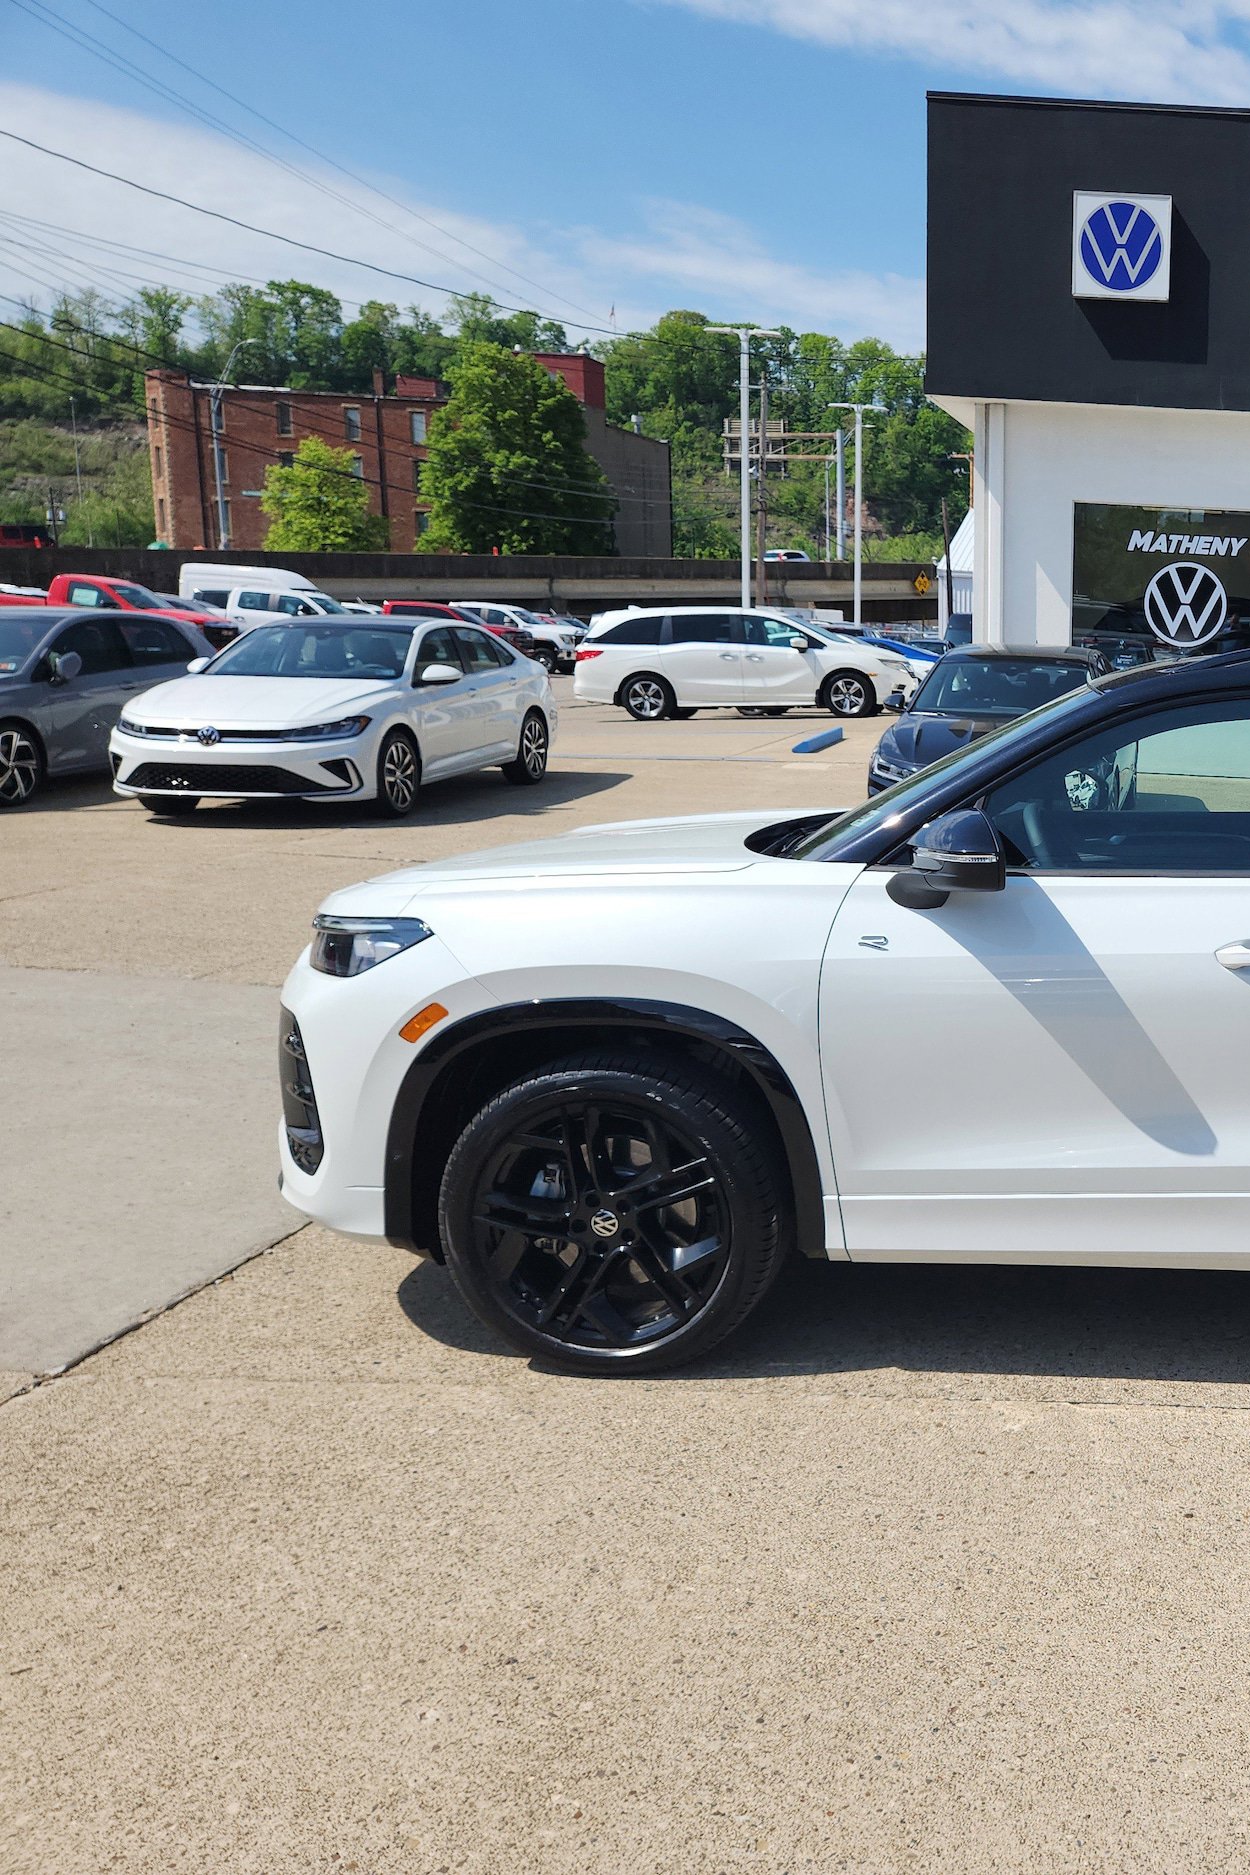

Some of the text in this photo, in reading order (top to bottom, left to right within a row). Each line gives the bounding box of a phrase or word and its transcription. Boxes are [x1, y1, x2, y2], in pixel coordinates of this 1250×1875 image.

[1080, 201, 1164, 291] VW
[1127, 529, 1248, 557] MATHENY
[1144, 561, 1227, 647] VW
